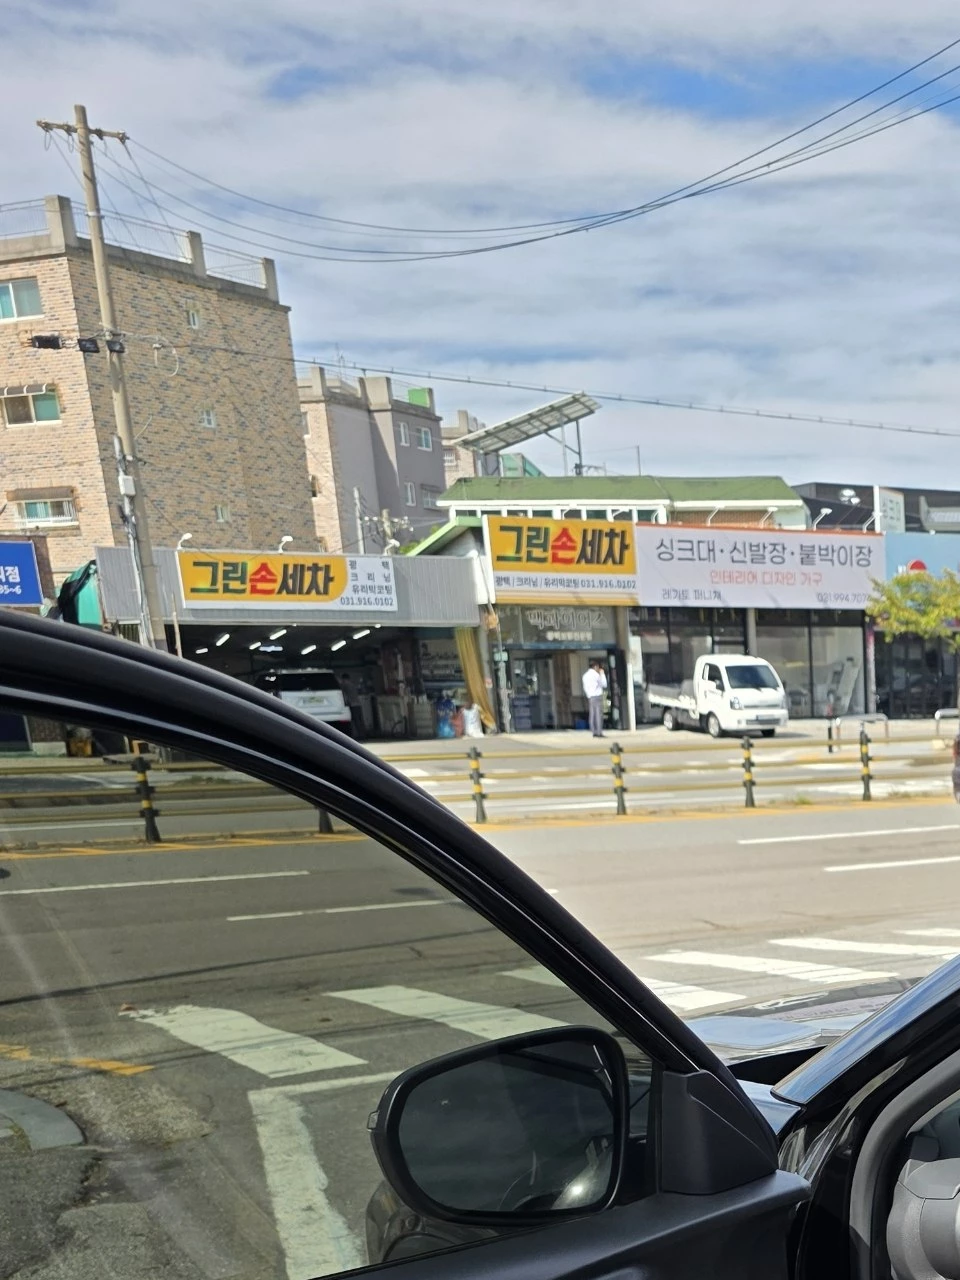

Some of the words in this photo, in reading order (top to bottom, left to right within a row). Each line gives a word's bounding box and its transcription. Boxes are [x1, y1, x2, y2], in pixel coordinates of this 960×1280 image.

[496, 525, 630, 565] 그린손세차
[190, 561, 335, 595] 그린손세차
[581, 578, 636, 590] 031.916.0102
[710, 570, 758, 585] 인테리어
[762, 571, 796, 586] 디자인
[801, 572, 823, 586] 가구
[340, 597, 394, 606] 031.916.0102
